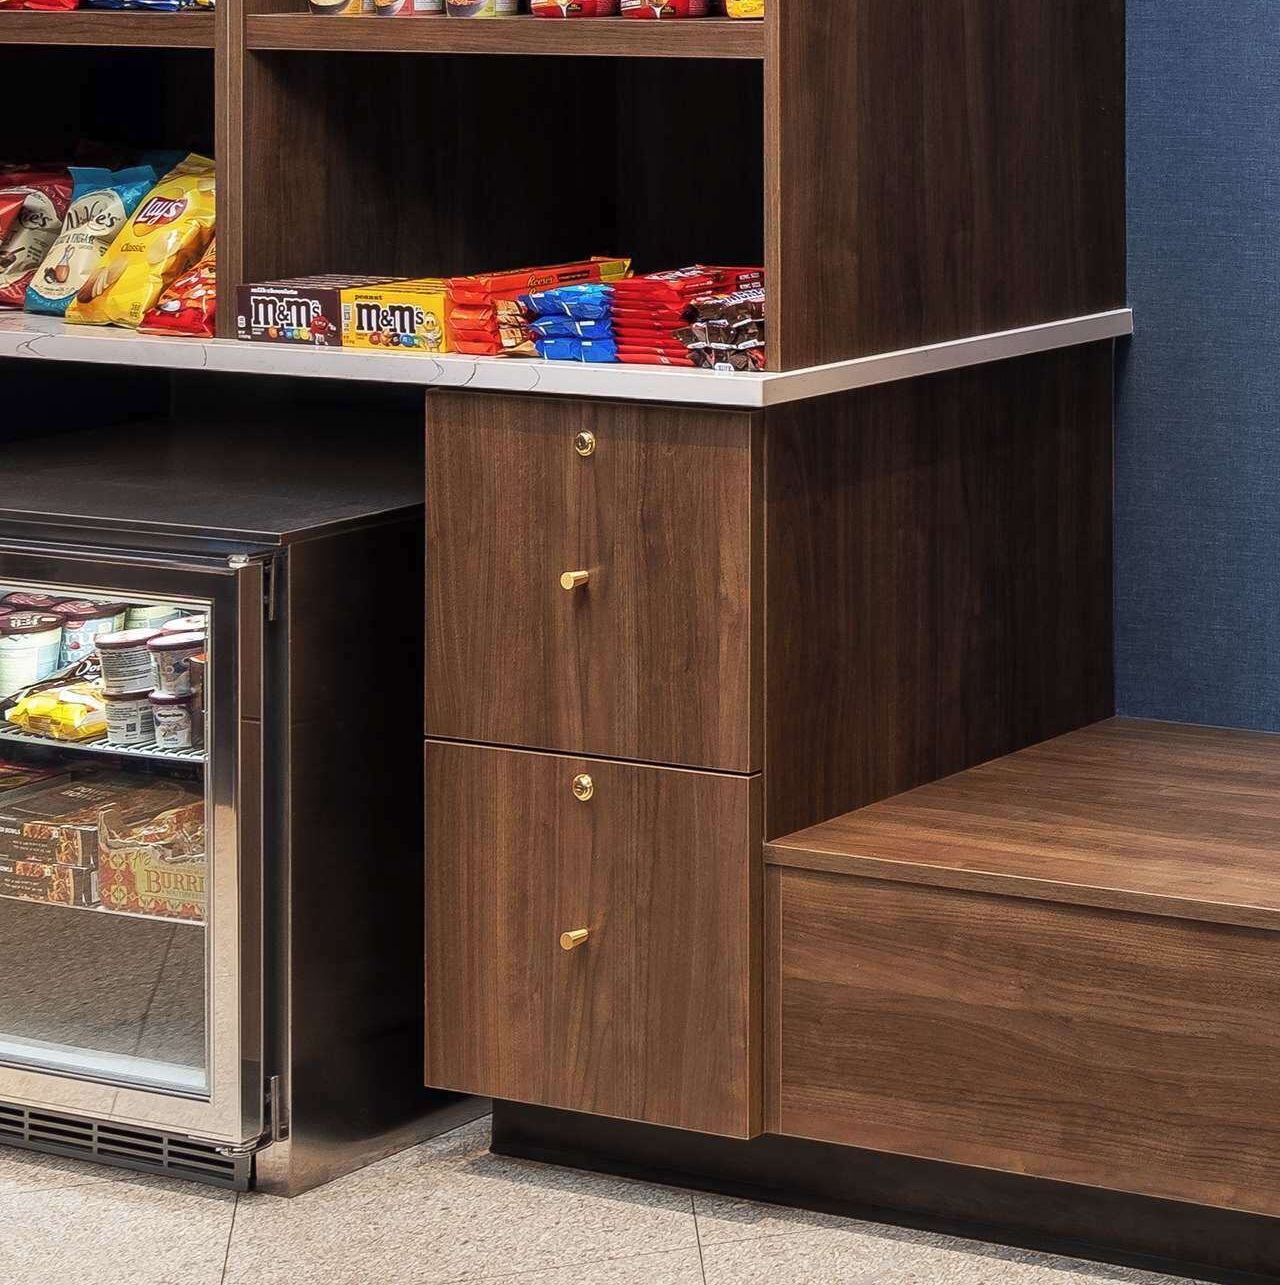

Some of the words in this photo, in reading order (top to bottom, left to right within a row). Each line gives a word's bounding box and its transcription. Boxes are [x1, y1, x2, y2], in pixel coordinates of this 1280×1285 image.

[120, 243, 145, 253] Classic
[251, 296, 321, 328] m&m's
[355, 302, 424, 334] m&m's
